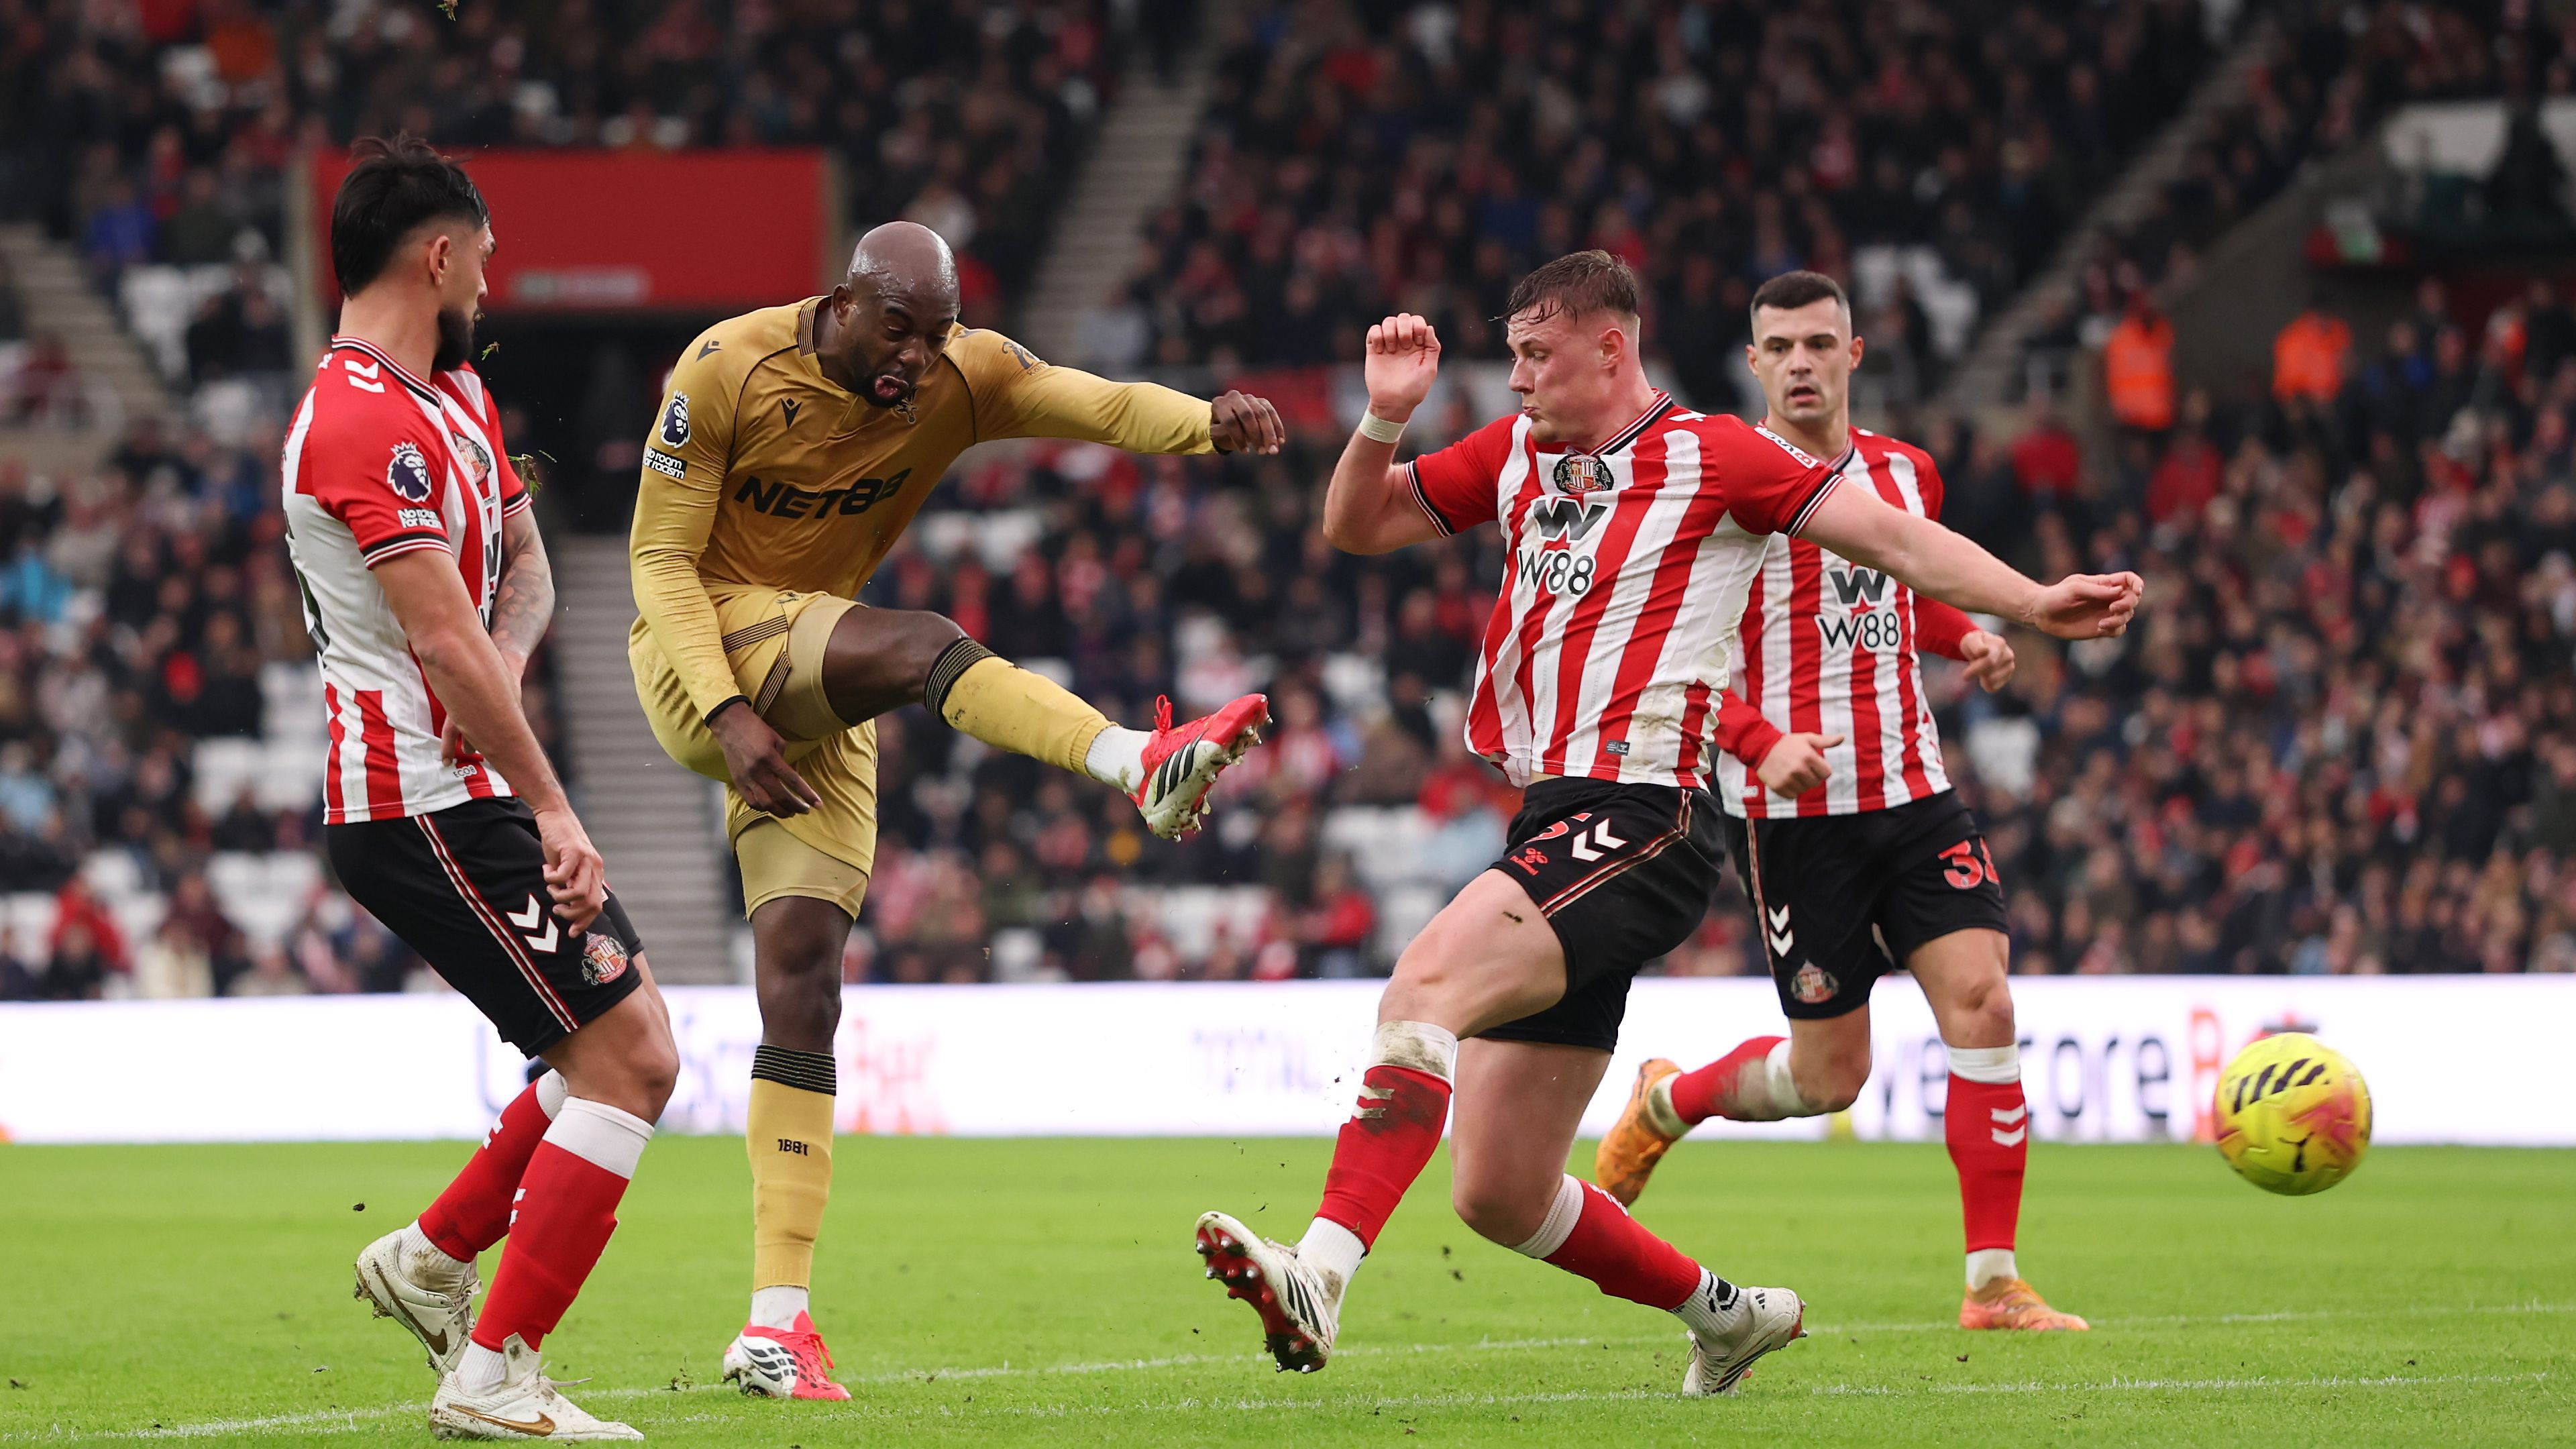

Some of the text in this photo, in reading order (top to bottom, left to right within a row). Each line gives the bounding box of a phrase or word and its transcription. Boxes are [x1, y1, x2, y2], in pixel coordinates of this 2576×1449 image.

[651, 461, 684, 479] racism
[655, 453, 682, 469] room
[734, 468, 912, 519] NET88
[397, 508, 417, 520] No
[1533, 498, 1608, 541] W
[1518, 549, 1594, 596] W88
[1829, 570, 1887, 604] W
[1819, 612, 1898, 649] W88
[777, 1138, 808, 1157] 1881
